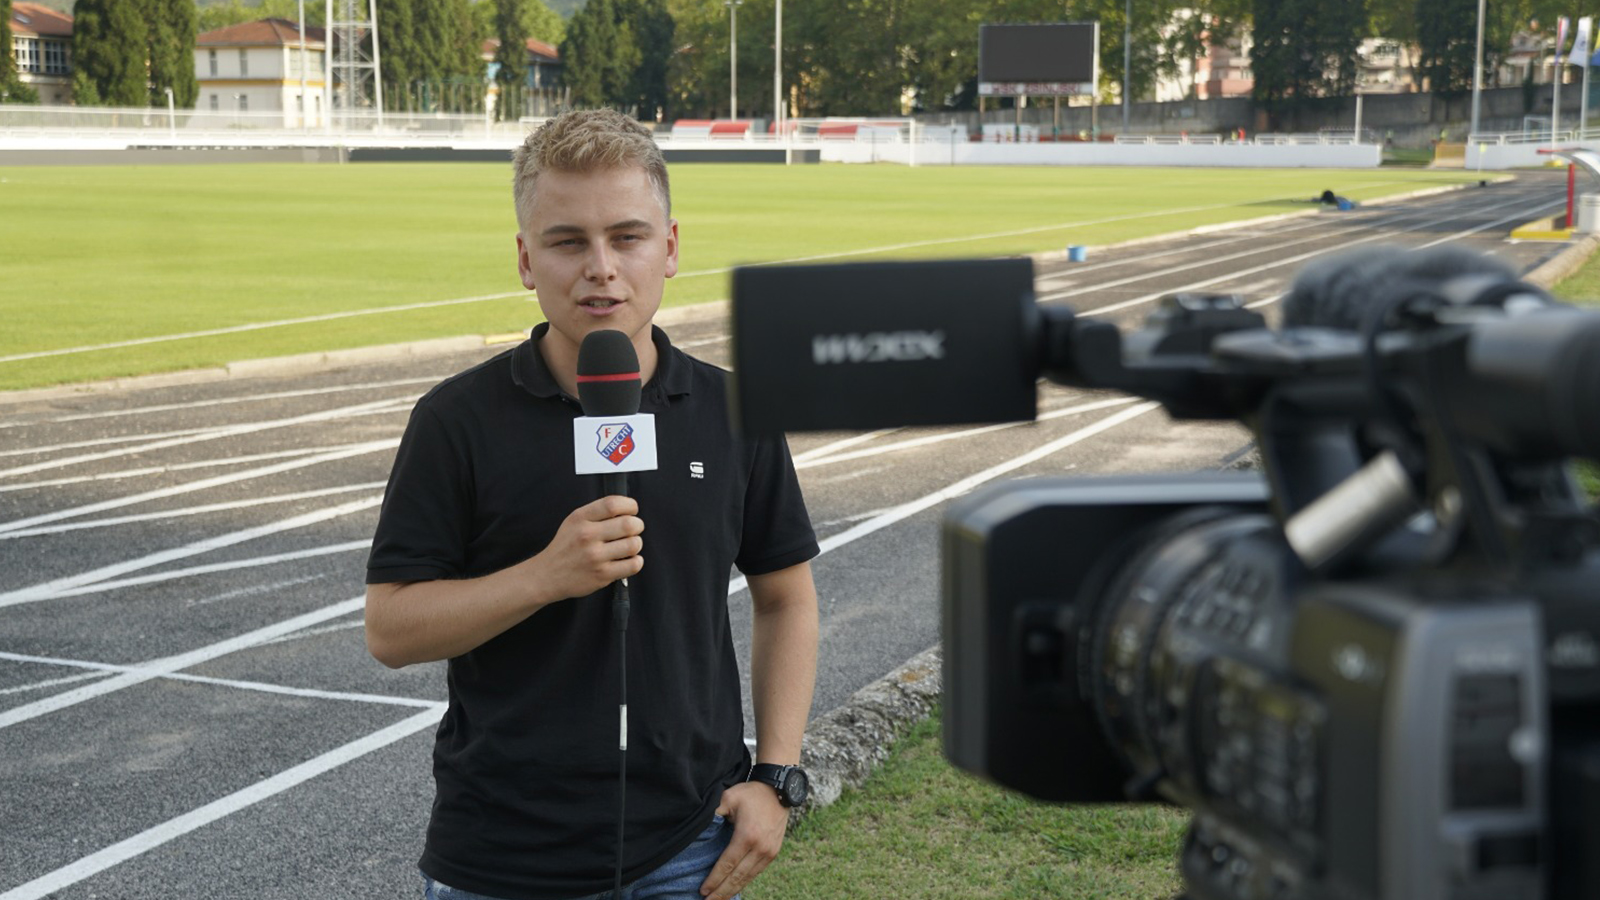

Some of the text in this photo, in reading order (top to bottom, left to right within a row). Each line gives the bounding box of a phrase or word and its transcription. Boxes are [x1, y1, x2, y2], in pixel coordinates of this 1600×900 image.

[605, 427, 611, 438] F
[602, 425, 631, 457] UTRECHT
[618, 445, 627, 455] C
